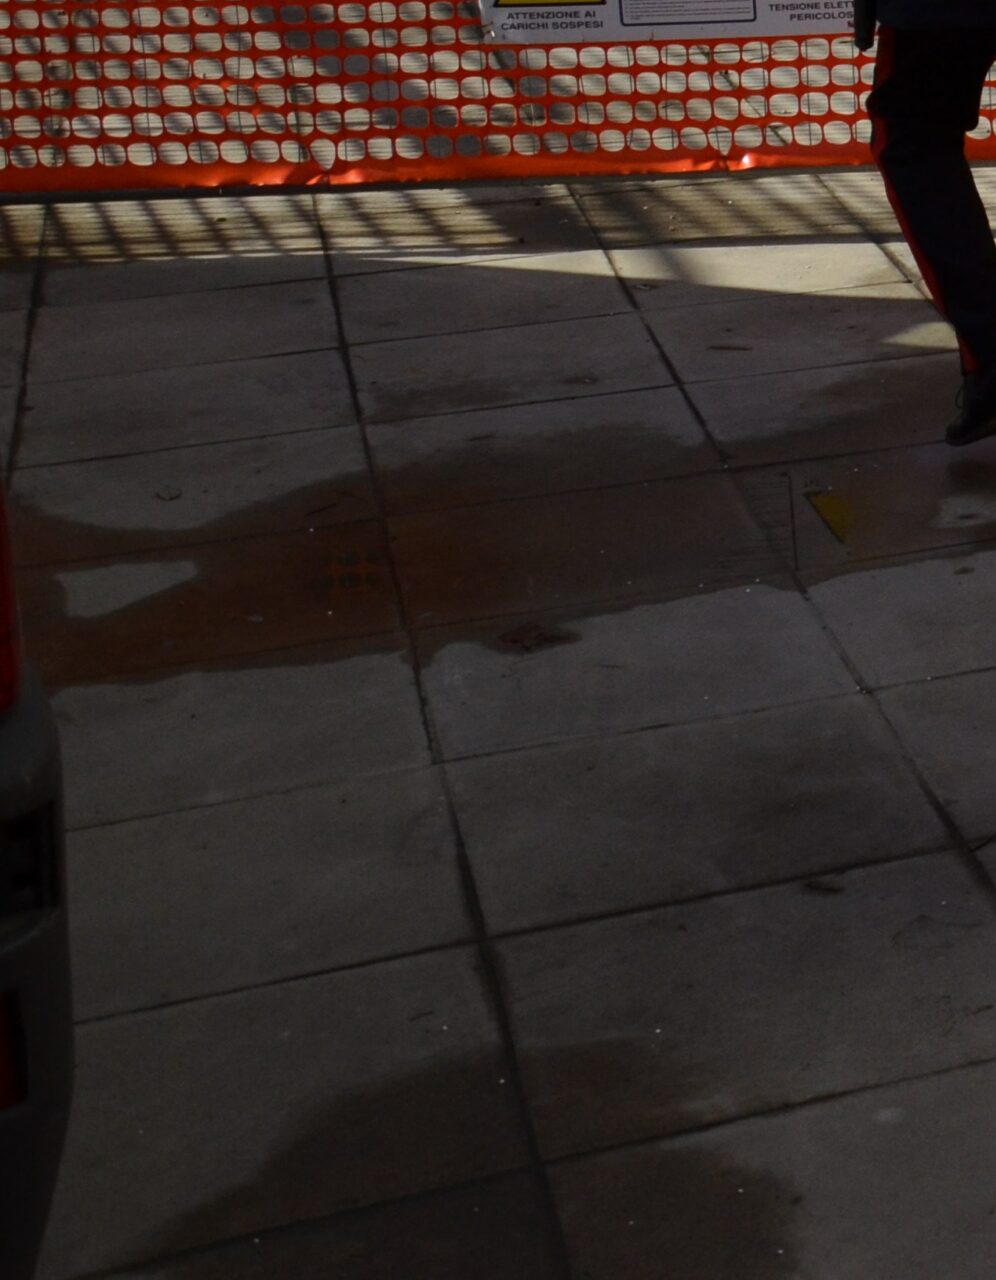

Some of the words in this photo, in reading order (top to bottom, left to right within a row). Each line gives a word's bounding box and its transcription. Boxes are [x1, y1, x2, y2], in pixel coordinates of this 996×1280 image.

[768, 2, 821, 12] TENSIONE
[506, 11, 581, 20] ATTENZIONE
[584, 10, 597, 18] AI
[500, 22, 549, 31] CARICHI
[551, 21, 604, 30] SOSPESI
